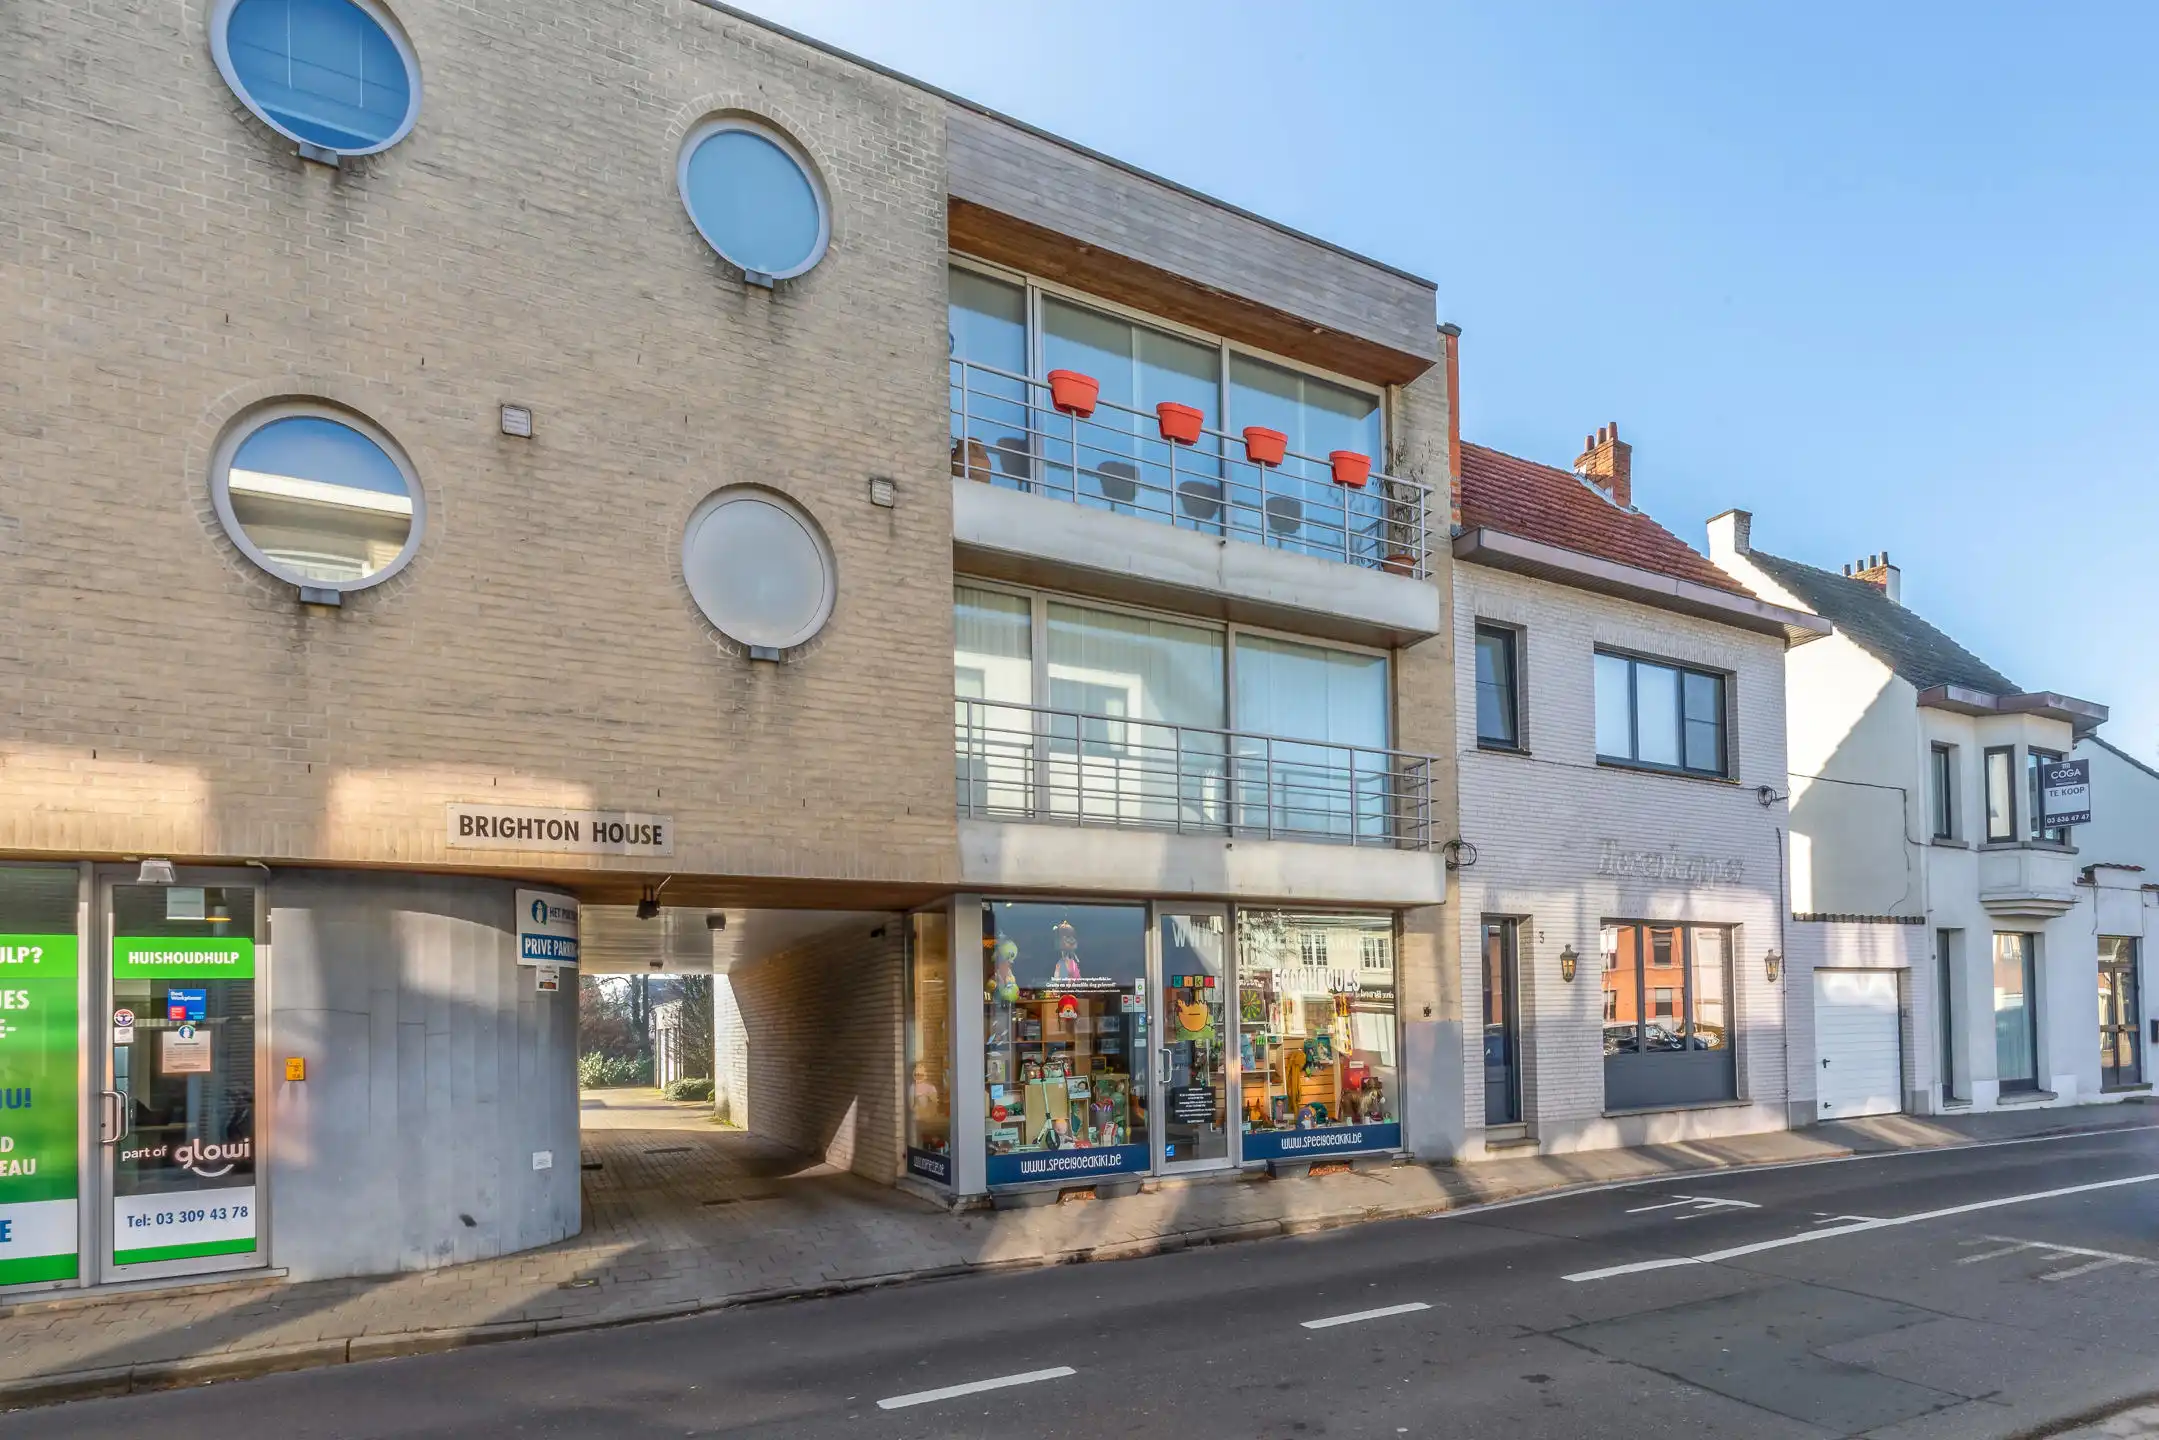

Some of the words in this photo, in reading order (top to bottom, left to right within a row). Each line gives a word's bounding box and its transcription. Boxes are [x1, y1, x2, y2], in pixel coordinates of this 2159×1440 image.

[2051, 768, 2081, 779] COGA
[2061, 787, 2085, 796] KOOP
[459, 814, 579, 841] BRIGHTON
[592, 821, 662, 845] HOUSE
[525, 938, 551, 956] PRIVE
[553, 940, 577, 957] PARK
[1539, 931, 1545, 944] 3
[128, 951, 240, 965] HUISHOUDHULP
[0, 989, 30, 1009] ES
[0, 1087, 32, 1109] U!
[122, 1147, 151, 1161] part
[153, 1145, 168, 1157] of
[174, 1137, 251, 1169] glowi
[1021, 1153, 1122, 1174] www.speelgoedkiki.be
[127, 1213, 151, 1228] Tel:
[156, 1212, 173, 1225] 03
[178, 1209, 205, 1223] 309
[210, 1207, 227, 1220] 43
[232, 1205, 249, 1218] 78
